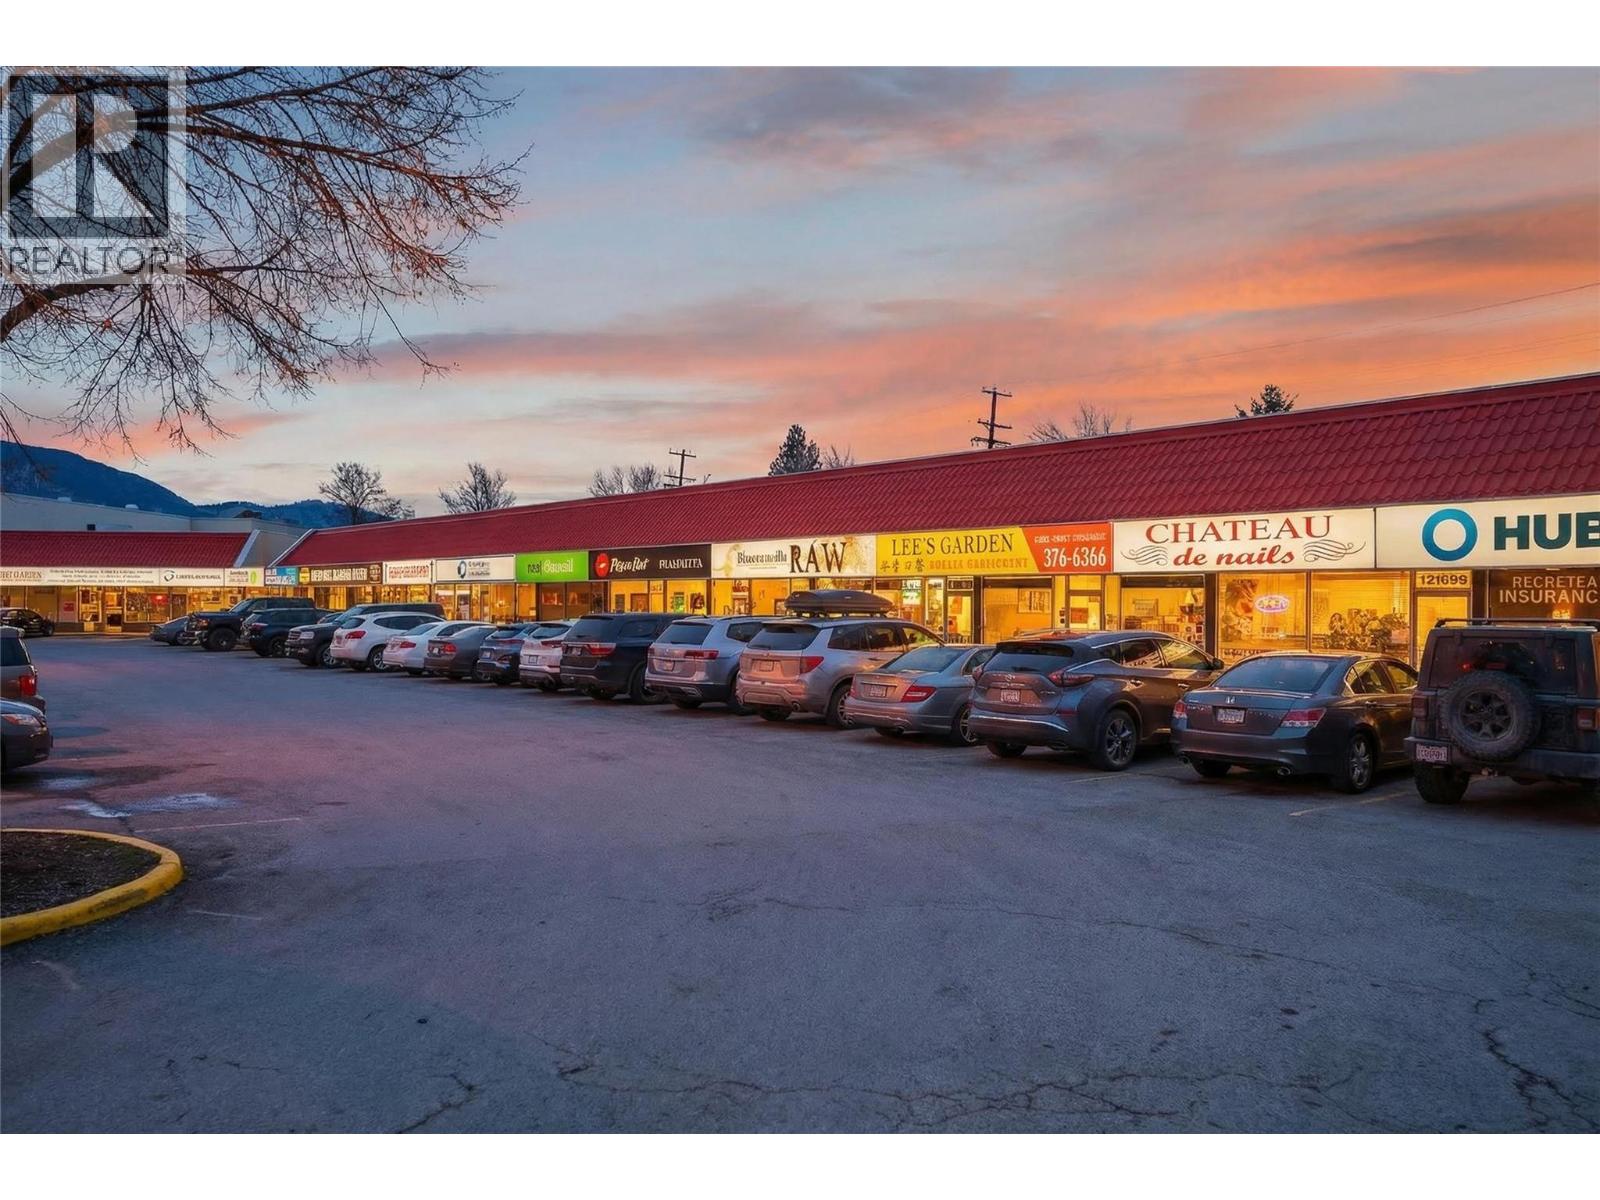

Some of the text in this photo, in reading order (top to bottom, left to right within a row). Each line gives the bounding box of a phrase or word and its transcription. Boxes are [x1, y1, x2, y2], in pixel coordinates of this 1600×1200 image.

[1145, 514, 1334, 544] CHATEAU
[1494, 512, 1600, 550] HUB
[891, 536, 936, 556] LEE'S
[940, 533, 1014, 554] GARDEN
[1173, 544, 1295, 566] de nails
[1044, 547, 1106, 567] 376-6366
[1500, 589, 1599, 604] INSURANC
